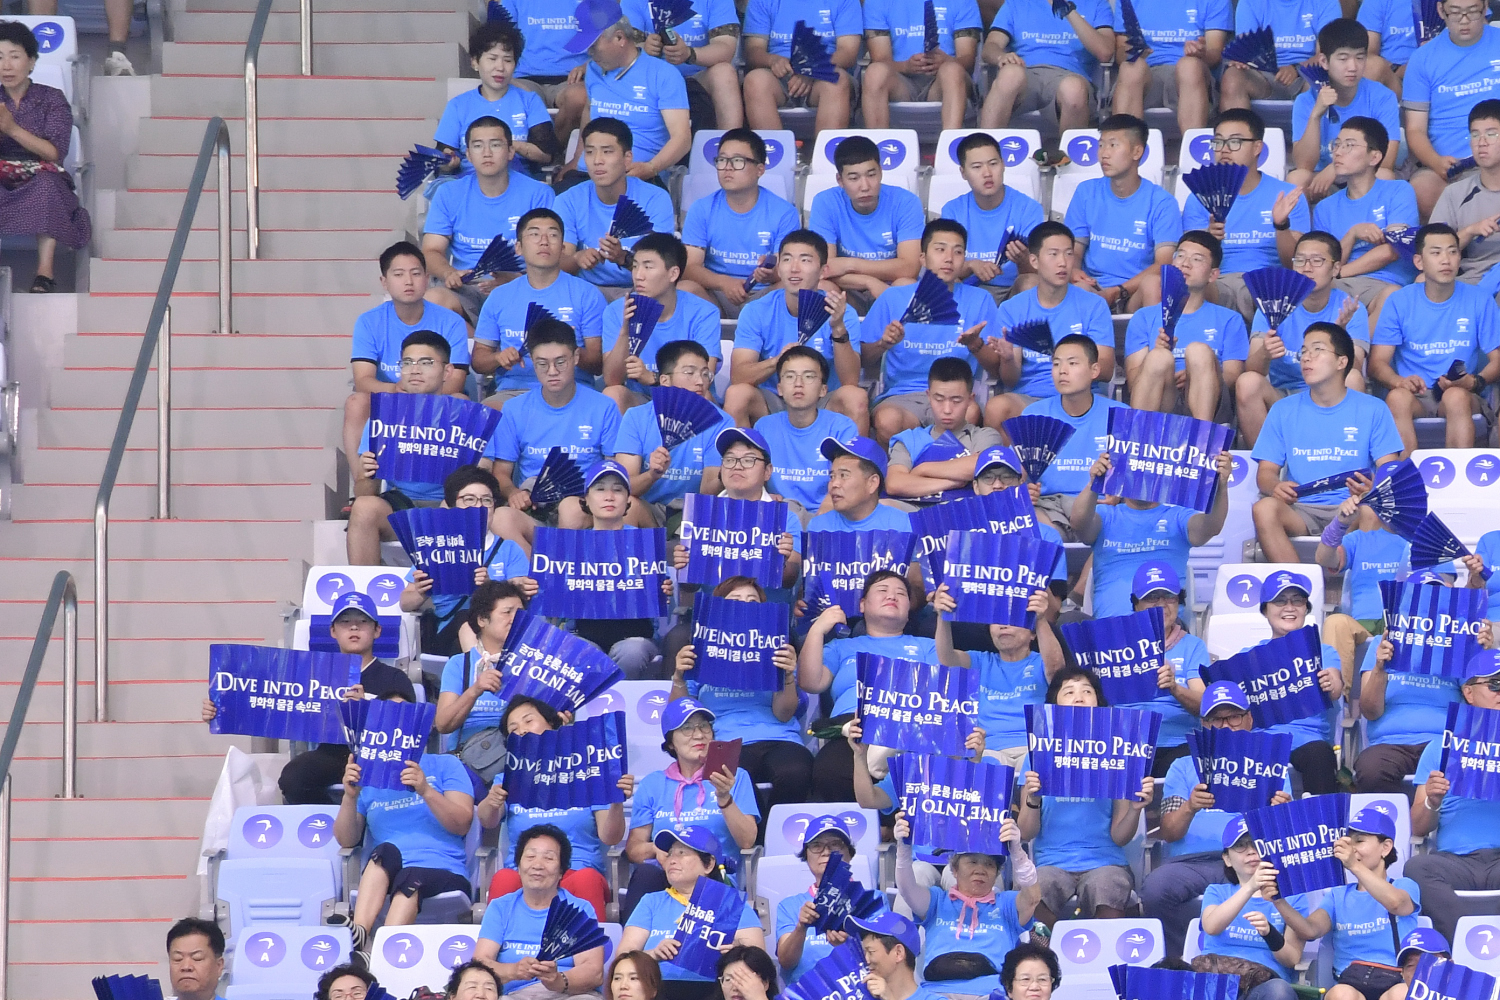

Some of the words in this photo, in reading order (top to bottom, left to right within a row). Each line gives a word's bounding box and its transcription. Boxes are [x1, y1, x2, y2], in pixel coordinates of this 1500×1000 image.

[1438, 83, 1458, 94] DIVE
[1459, 82, 1482, 92] INTO
[372, 420, 407, 438] DIVE
[410, 426, 445, 442] INTO
[450, 425, 487, 452] PEACE
[398, 442, 422, 454] 평화의
[424, 444, 438, 456] 물결
[440, 446, 458, 458] 속으로
[1107, 435, 1139, 455] DIVE
[1144, 444, 1181, 462] INTO
[1188, 446, 1218, 471] PEAC
[1129, 459, 1155, 473] 평화의
[1156, 463, 1173, 476] 물결
[1175, 466, 1198, 479] 속으로
[533, 554, 574, 575] DIVE
[581, 563, 621, 575] INTO
[627, 557, 666, 575] PEAC
[567, 579, 593, 591] 평화의
[596, 579, 614, 591] 물결
[617, 579, 644, 590] 속으로
[216, 672, 257, 692] DIVE
[264, 680, 303, 696] INTO
[250, 696, 274, 709] 평화의
[276, 699, 293, 711] 물결
[295, 701, 321, 712] 속으로
[1030, 732, 1062, 753] DIVE
[1068, 739, 1106, 754] INTO
[1110, 736, 1152, 759] PEACE
[1054, 756, 1079, 768] 평화의
[1081, 758, 1098, 769] 물결
[1100, 758, 1125, 770] 속으로
[258, 834, 267, 843] A
[260, 952, 269, 962] A
